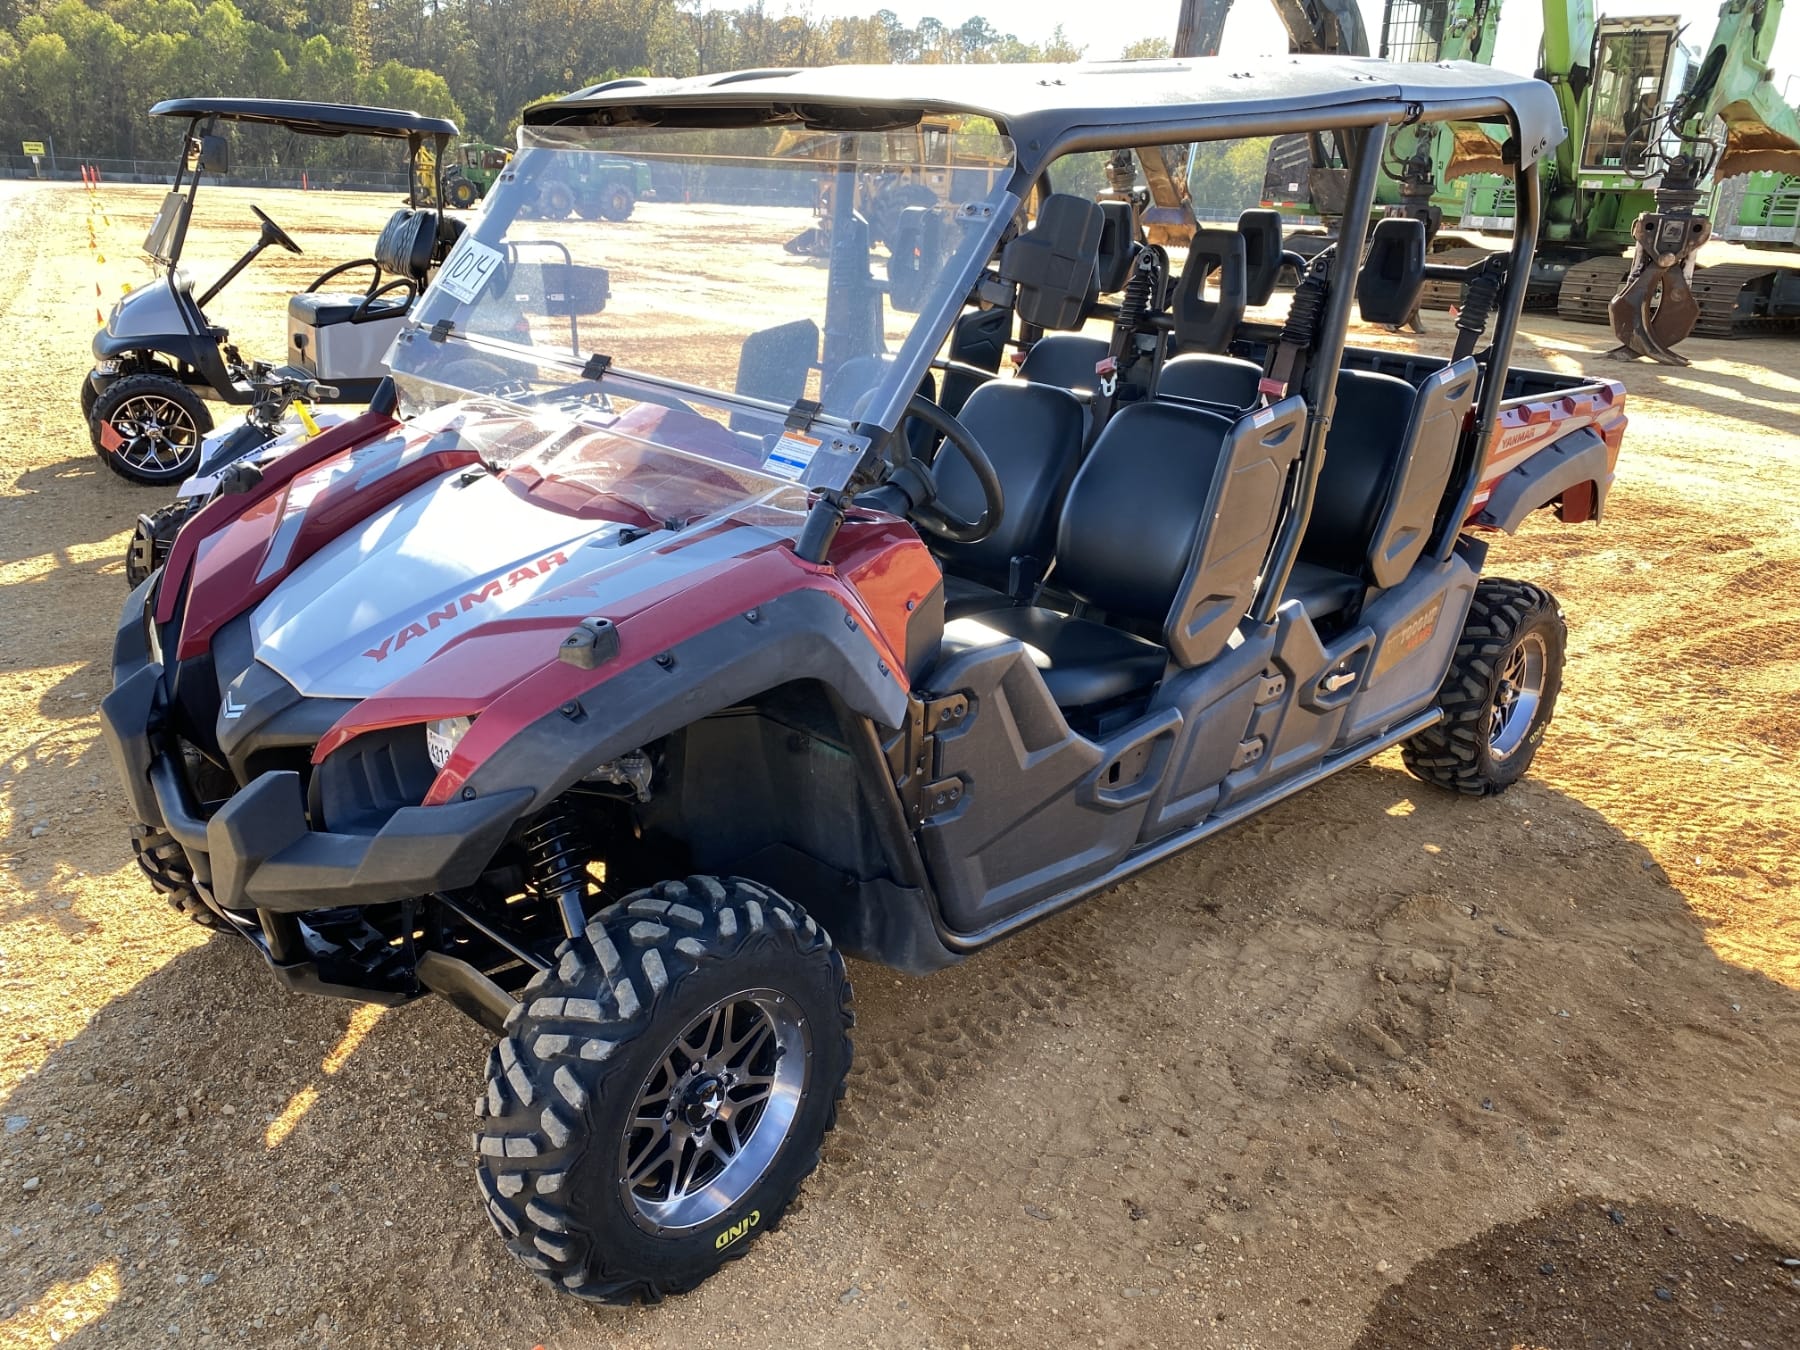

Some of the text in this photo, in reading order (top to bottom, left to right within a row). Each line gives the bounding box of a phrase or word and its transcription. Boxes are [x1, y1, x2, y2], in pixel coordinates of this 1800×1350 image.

[445, 246, 496, 290] 1014
[1502, 427, 1536, 450] YANMAR
[361, 551, 569, 663] YANMAR
